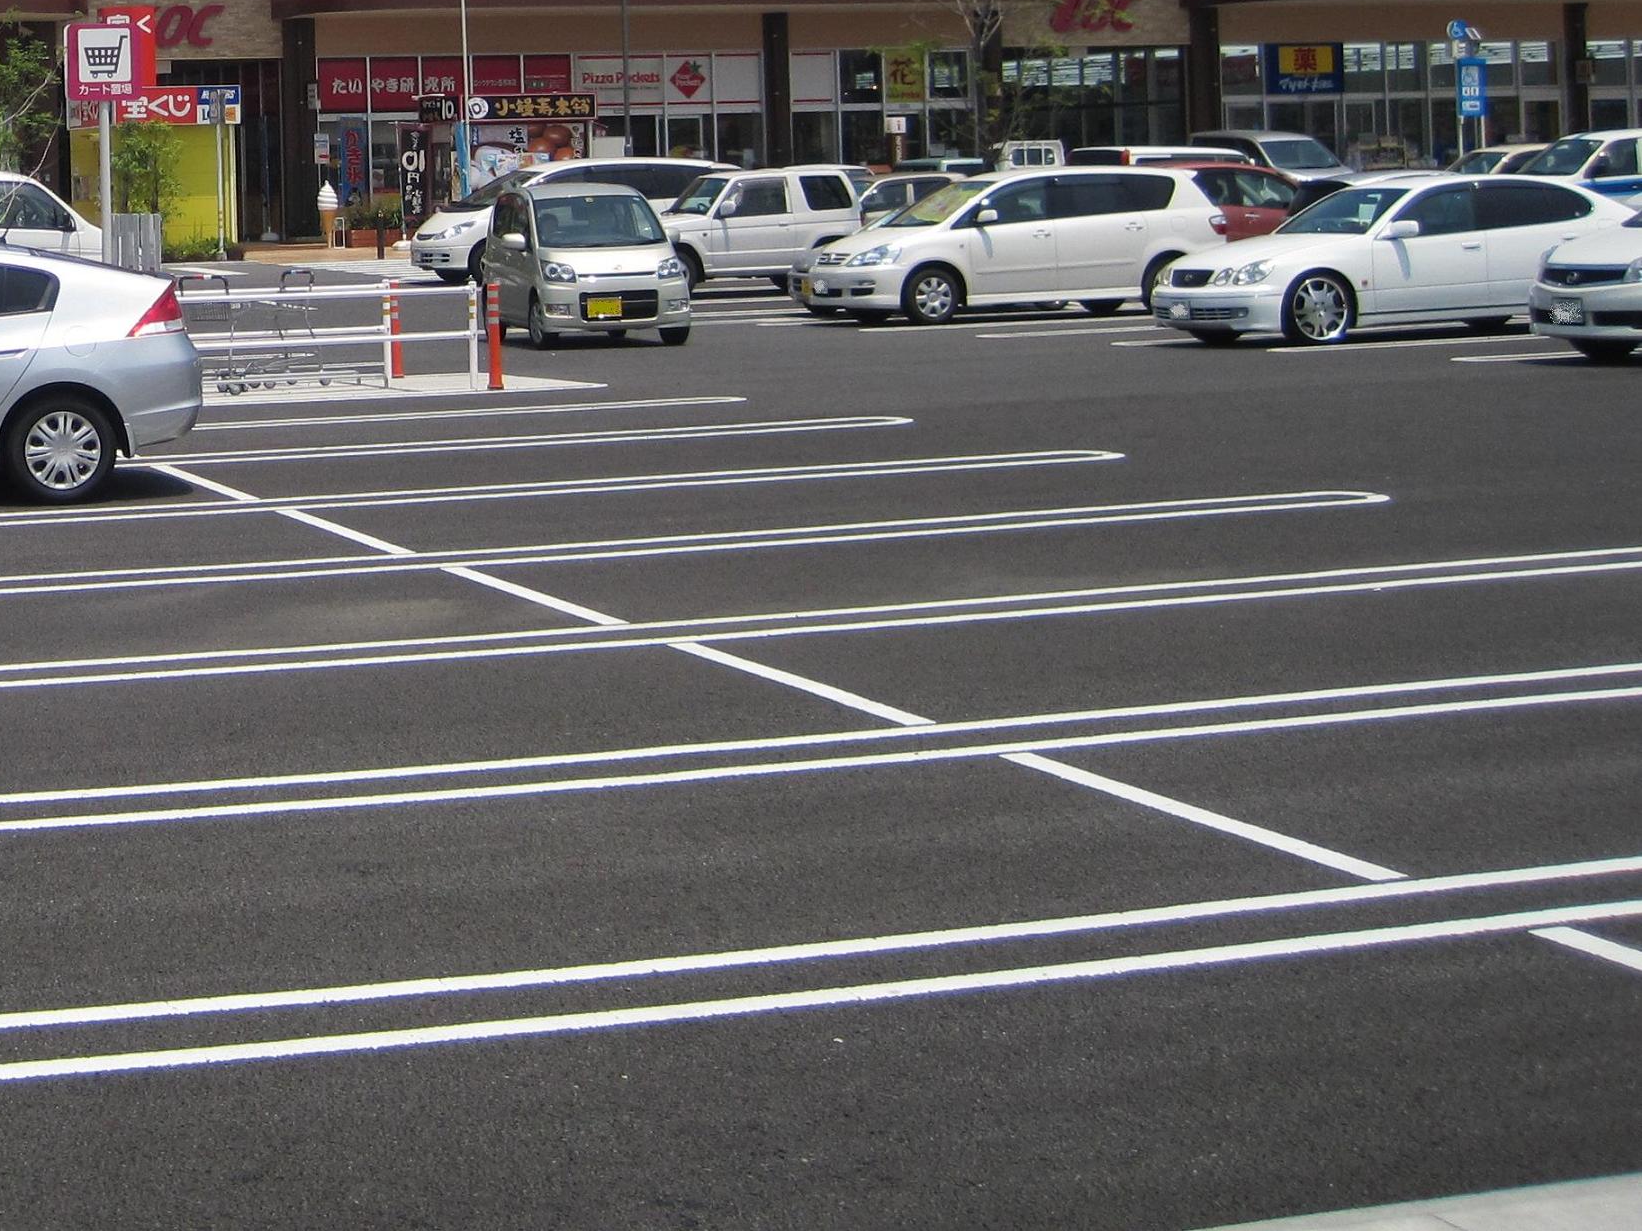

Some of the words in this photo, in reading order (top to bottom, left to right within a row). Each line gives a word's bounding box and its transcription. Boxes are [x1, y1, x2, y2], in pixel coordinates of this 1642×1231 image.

[157, 4, 226, 49] OC
[582, 71, 614, 85] Pizza
[615, 70, 661, 85] Pckets
[889, 57, 916, 86] 花
[78, 84, 133, 96] カート置場
[121, 93, 192, 119] 宝くじ
